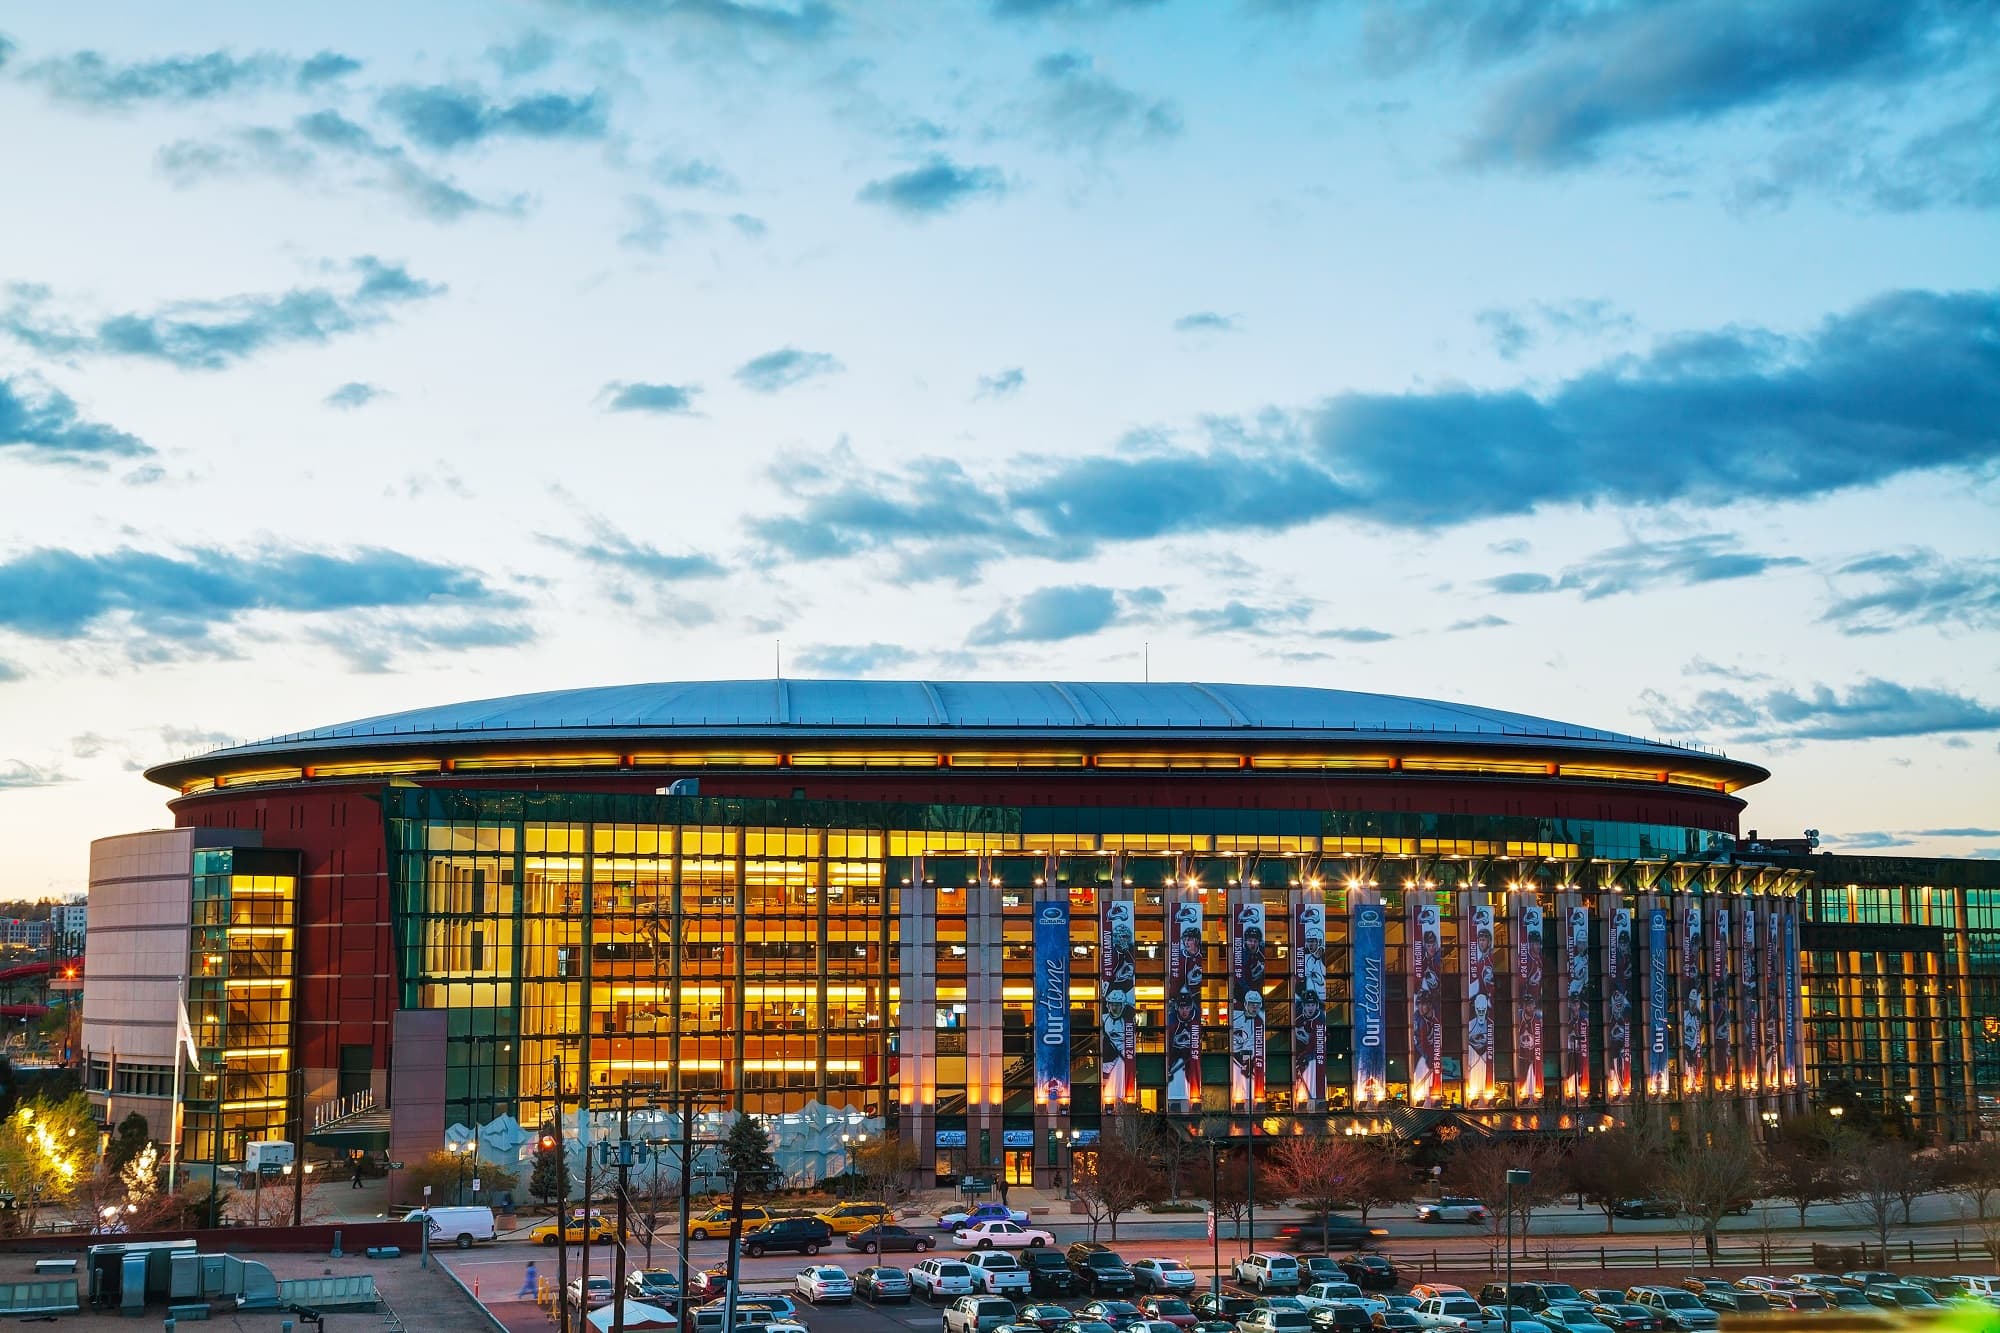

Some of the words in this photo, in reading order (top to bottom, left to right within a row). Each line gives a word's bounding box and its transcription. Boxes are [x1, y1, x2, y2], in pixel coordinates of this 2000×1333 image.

[1103, 930, 1112, 966] VARLAMOV
[1171, 942, 1180, 966] BARRIE
[1234, 937, 1242, 967] JOHNSON
[1296, 946, 1304, 967] HEJDA
[1040, 957, 1065, 1012] time
[1357, 957, 1381, 1015] team
[1043, 1011, 1064, 1045] Our
[1125, 1022, 1134, 1048] HOLDEN
[1255, 1024, 1263, 1057] MITCHELL
[1316, 1023, 1324, 1054] DUCHENE
[1362, 1015, 1380, 1047] Our
[1433, 1023, 1441, 1061] PARENTEAU
[1652, 1023, 1665, 1053] Our
